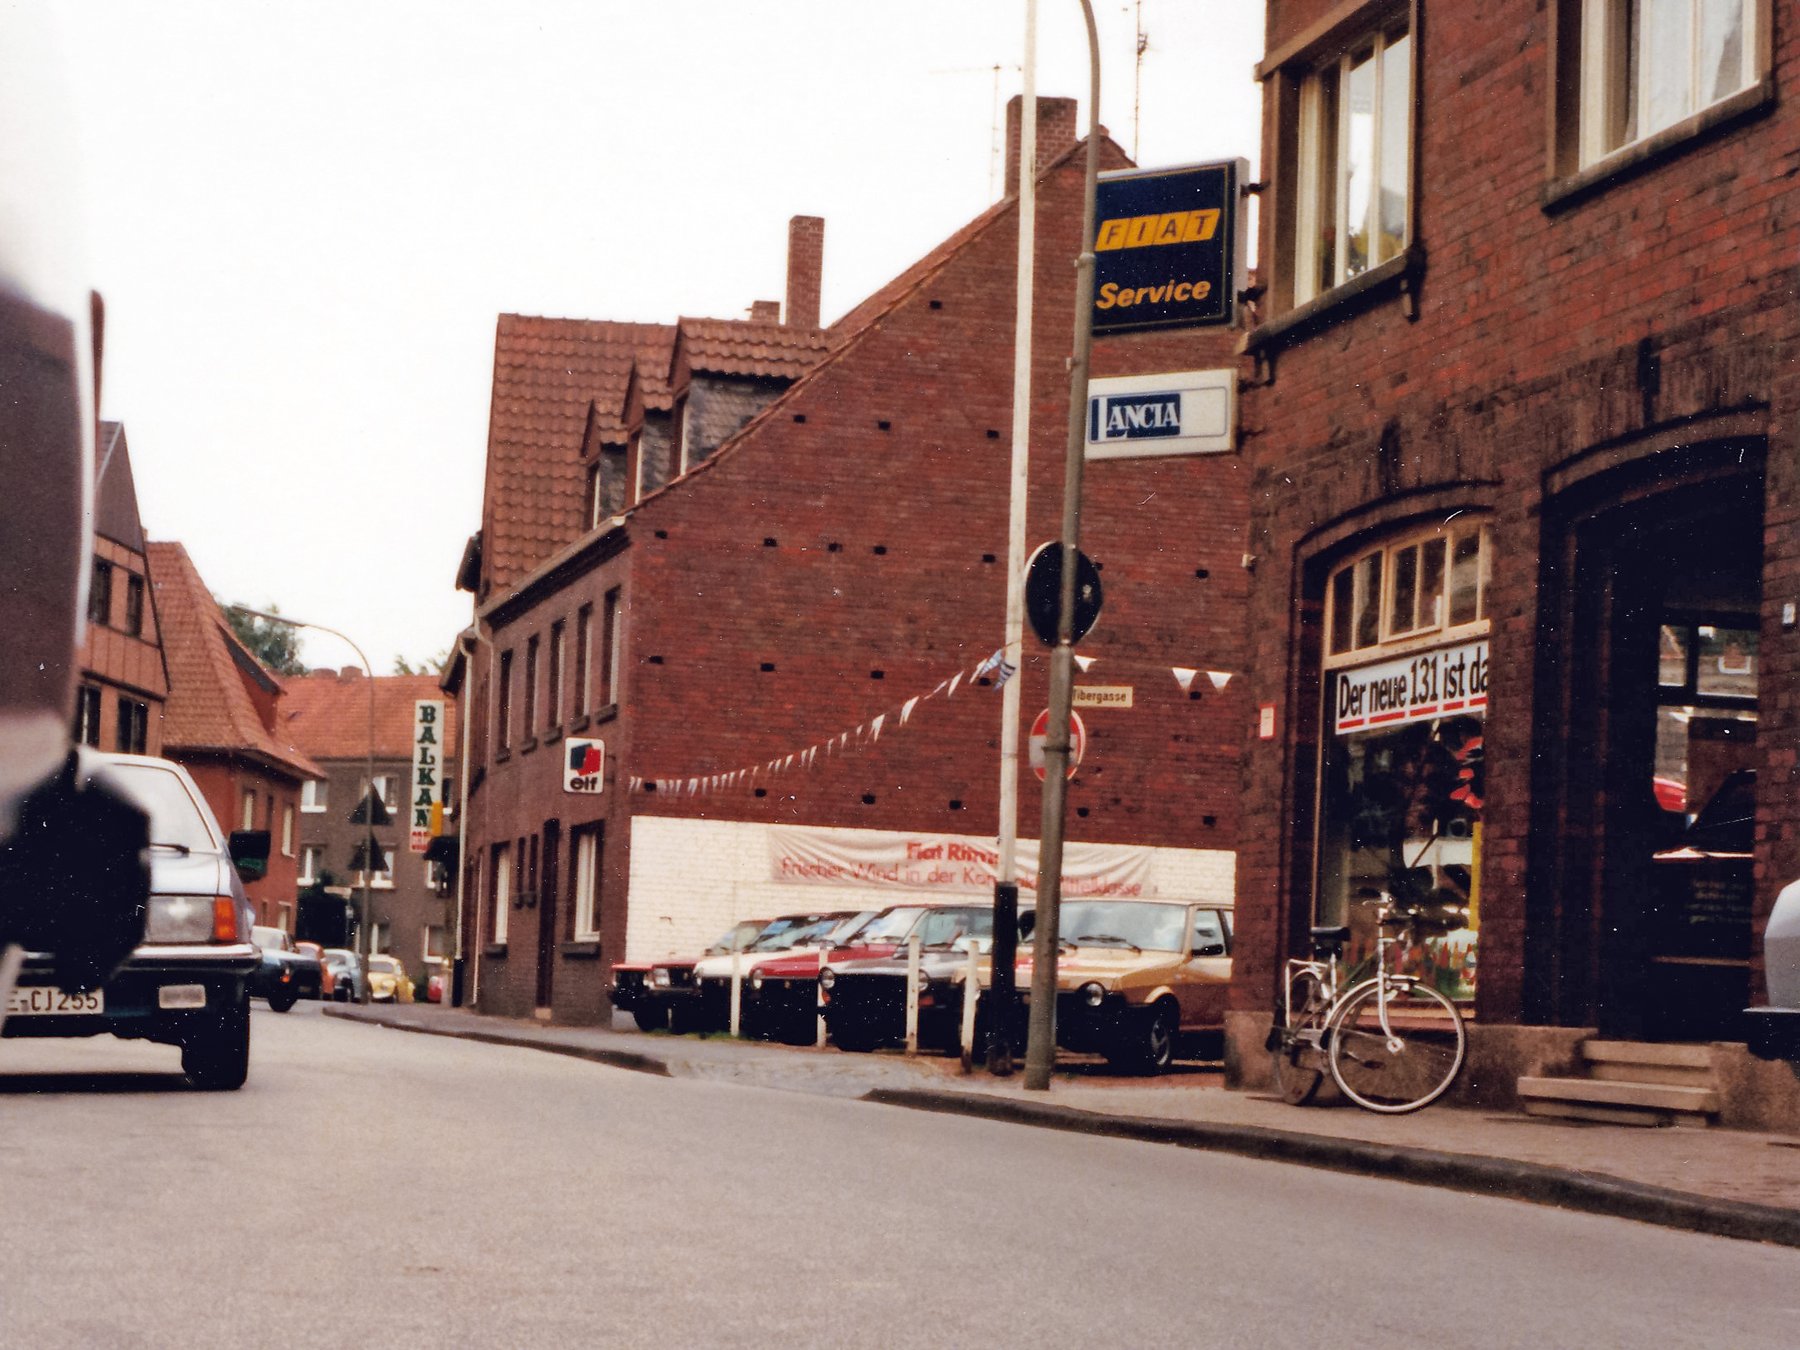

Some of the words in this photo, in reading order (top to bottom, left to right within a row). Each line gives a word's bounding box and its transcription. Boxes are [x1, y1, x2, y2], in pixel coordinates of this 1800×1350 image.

[1104, 213, 1214, 246] FIAT
[1096, 279, 1212, 310] Service
[1091, 393, 1180, 441] LANCIA
[1338, 673, 1367, 719] Der
[1369, 674, 1408, 713] neue
[1410, 655, 1439, 706] 131
[1443, 651, 1466, 700] ist
[414, 705, 437, 827] BALKAN
[569, 776, 598, 791] elf
[906, 842, 944, 860] Fiat
[853, 862, 899, 883] Wind
[905, 867, 921, 883] in
[927, 865, 957, 885] der
